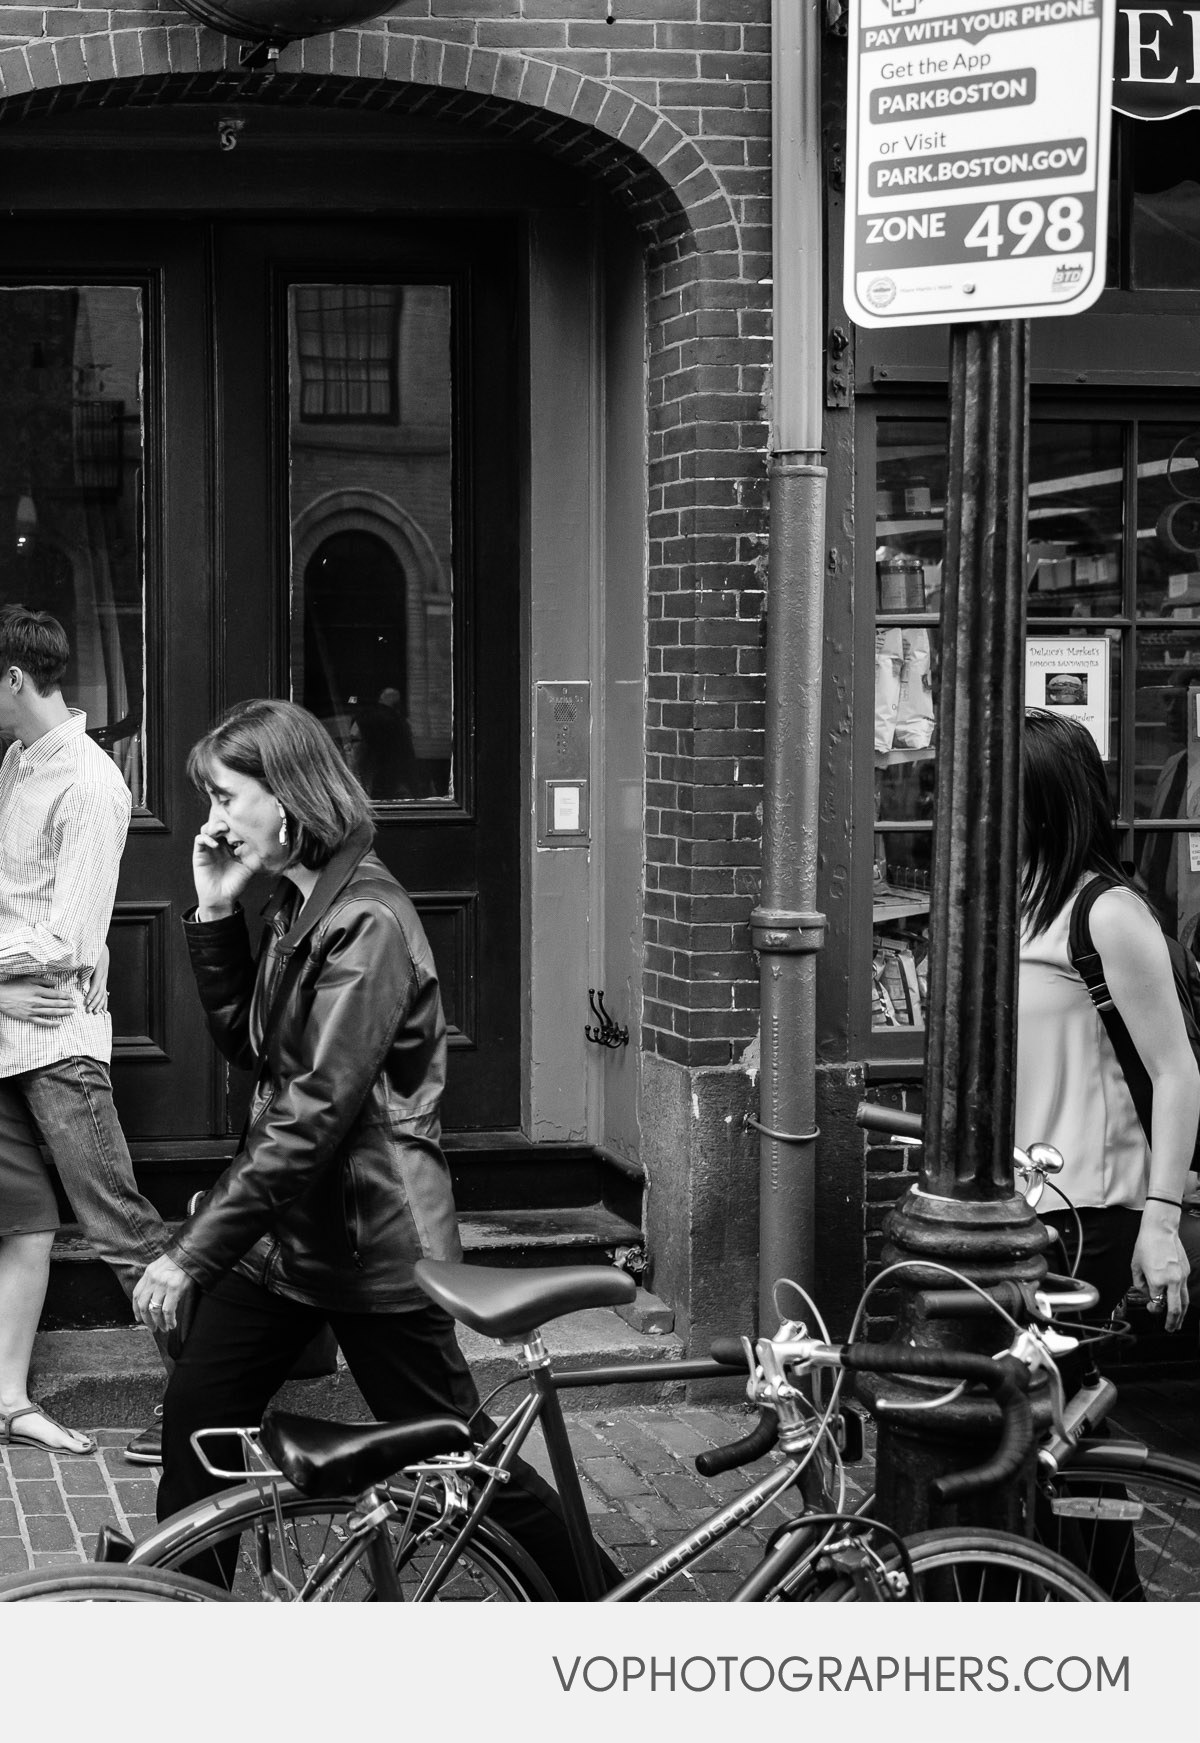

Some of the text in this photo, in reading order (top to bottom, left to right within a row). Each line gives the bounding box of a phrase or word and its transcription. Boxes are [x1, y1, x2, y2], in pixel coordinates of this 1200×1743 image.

[865, 0, 1095, 48] PAY WITH YOUR PHONE
[880, 52, 991, 79] Get the App
[877, 78, 1028, 116] PARKBOSTON
[879, 132, 946, 155] or Visit
[876, 146, 1084, 188] PARK.BOSTON.GOV
[865, 197, 1085, 258] ZONE 498
[1054, 271, 1081, 284] BTD
